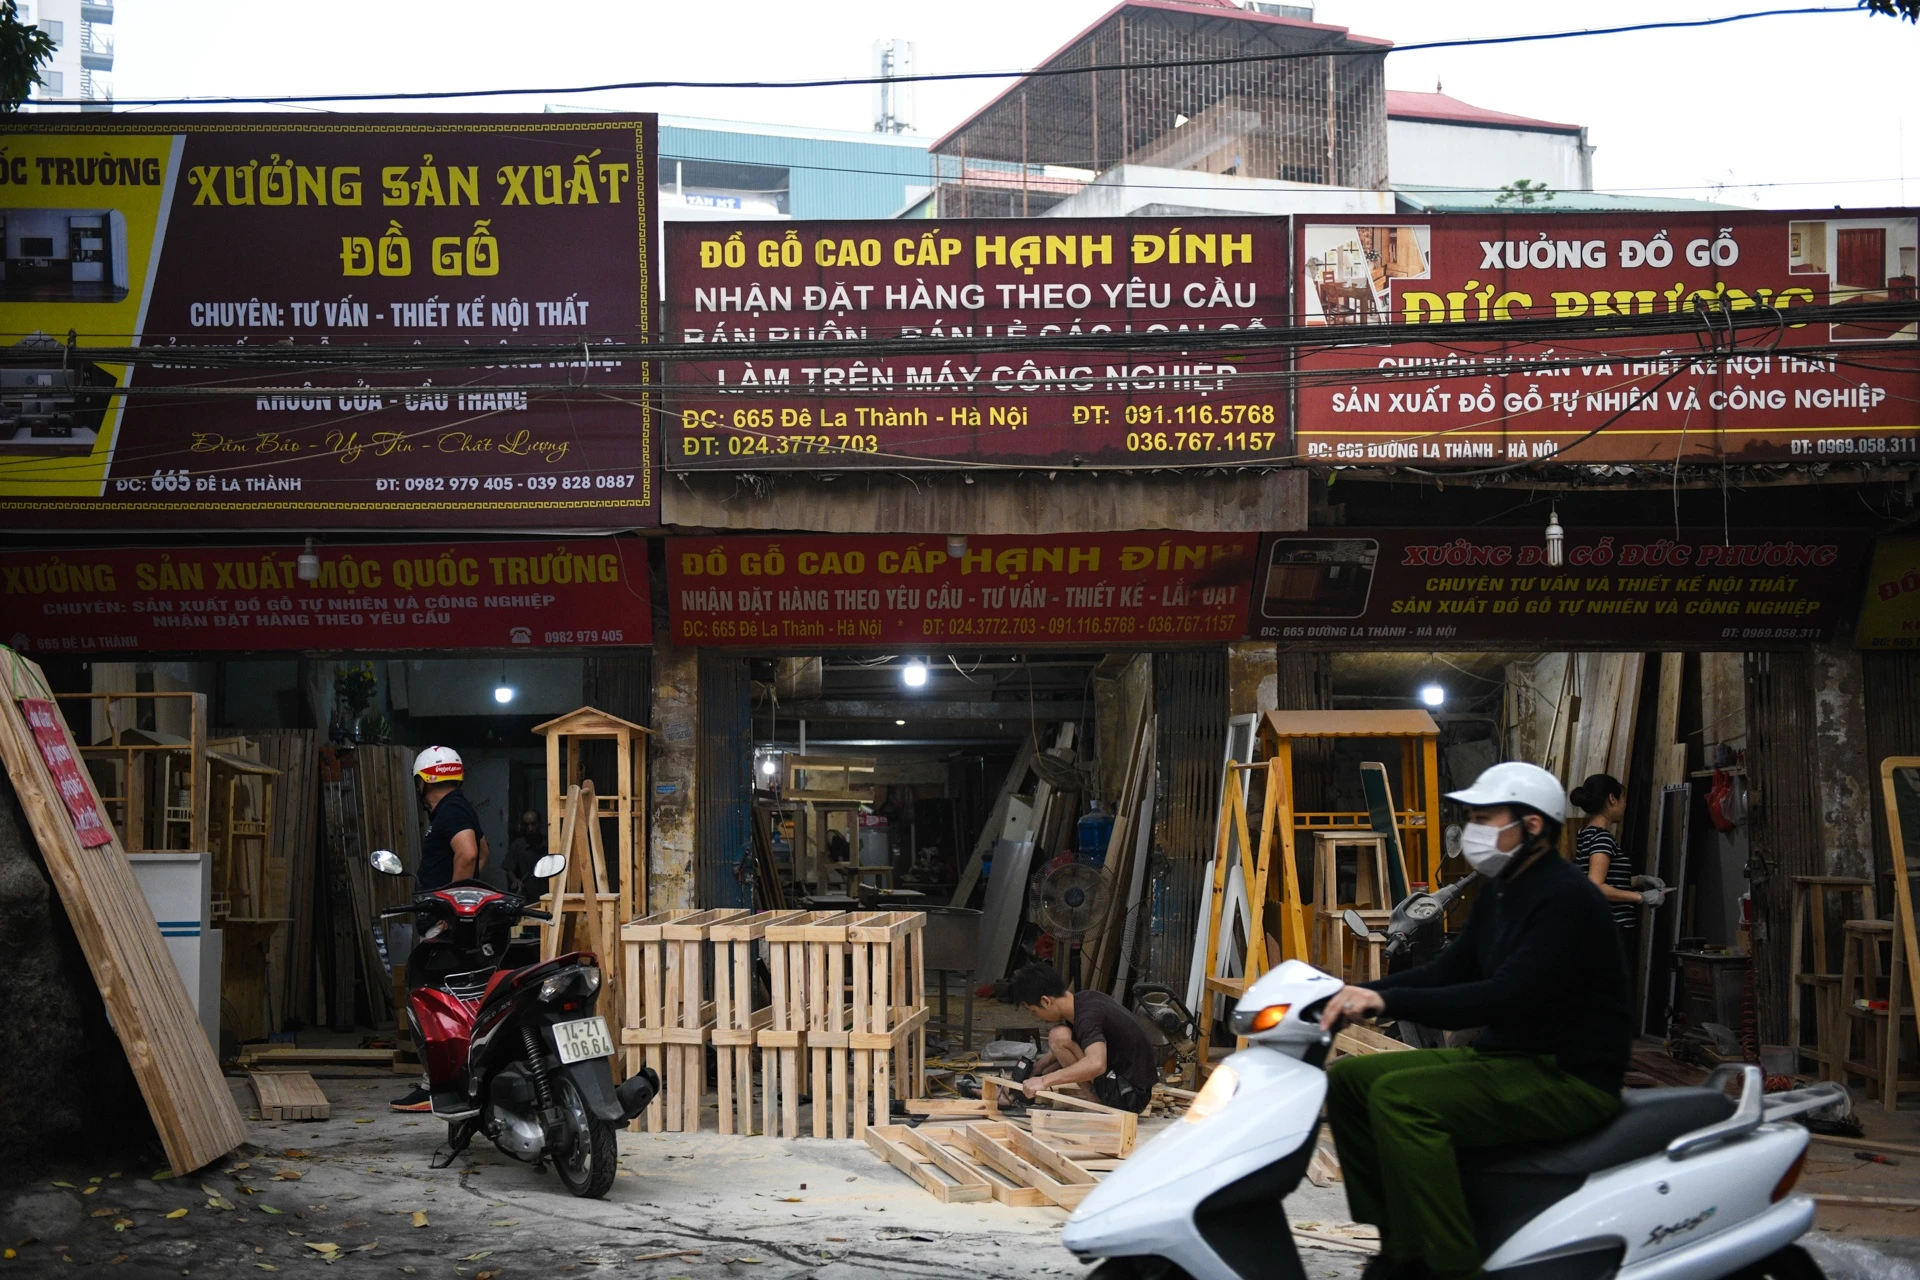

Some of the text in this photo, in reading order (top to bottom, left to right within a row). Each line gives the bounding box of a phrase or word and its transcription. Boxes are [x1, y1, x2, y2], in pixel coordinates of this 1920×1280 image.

[36, 151, 160, 186] TRƯỜNG
[188, 148, 629, 206] XƯỞNG SẢN XUẤT
[340, 219, 499, 276] ĐỒ GỖ
[700, 228, 1252, 275] ĐỒ GỖ CAO CẤP HẠNH ĐÍNH
[1479, 227, 1739, 270] XƯỞNG ĐỒ GỖ
[695, 276, 1257, 317] NHẬN ĐẶT HÀNG THEO YÊU CẦU
[190, 292, 590, 332] CHUYÊN: TƯ VẤN THIẾT KẾ NỘI THẤT
[1332, 383, 1886, 417] SẢN XUẤT ĐỒ GỖ TỰ NHIÊN VÀ CÔNG NGHIỆP
[682, 405, 1275, 430] ĐC: 665 Đê La Thành Hà Nội ĐT: 091.116.5768
[255, 432, 301, 453] Bảo
[683, 434, 878, 456] ĐT: 024.3772.703
[1126, 432, 1276, 452] 036.767.1157
[1422, 440, 1528, 458] LA THÀNH HÀ
[1791, 437, 1917, 455] ĐT: 0969.058.311
[116, 470, 302, 491] ĐC: 665 ĐÊ LA THÀNH
[376, 475, 635, 491] ĐT: 0982 979 405 039 828 0887
[682, 542, 1100, 580] ĐỒ GỖ CAO CẤP HẠNH
[1402, 536, 1839, 567] XƯỞNG GỖ ĐỨC PHƯƠNG
[2, 546, 619, 594] XƯỞNG SẢN XUẤT MỘC QUỐC TRƯỞNG
[1425, 573, 1743, 595] CHUYÊN TƯ VÀ THIẾT NỘI
[328, 592, 556, 611] NHIÊN VÀ CÔNG NGHIỆP
[681, 586, 733, 616] NHẬN
[738, 586, 772, 615] ĐẶT
[778, 585, 829, 611] HÀNG
[834, 589, 880, 610] THEO
[886, 584, 920, 610] YÊU
[926, 580, 963, 609] CẦU
[982, 585, 1007, 609] TƯ
[1010, 580, 1047, 609] VẤN
[1066, 580, 1114, 609] THIẾT
[1391, 595, 1433, 614] SẢN
[1558, 599, 1584, 617] TỰ
[1586, 598, 1650, 614] NHIÊN
[1654, 598, 1680, 614] VÀ
[1688, 597, 1741, 615] CÔNG
[1745, 598, 1821, 618] NGHIỆP
[153, 610, 406, 630] NHẬN HÀNG THEO YÊU
[683, 614, 1236, 640] ĐC: 665 Đê La Thành Hà Nội ĐT: 024.3772.703 091.116.5768 036.767.1157
[1283, 626, 1304, 637] 665
[1350, 627, 1365, 637] LA
[1368, 625, 1406, 637] THÀNH
[1416, 625, 1433, 637] HÀ
[37, 633, 139, 649] 665 LA THÀNH
[545, 630, 623, 643] 0982 979 405
[1742, 627, 1822, 639] 0969.058.311
[563, 1020, 600, 1042] 14-Z1
[563, 1037, 610, 1061] 106.64
